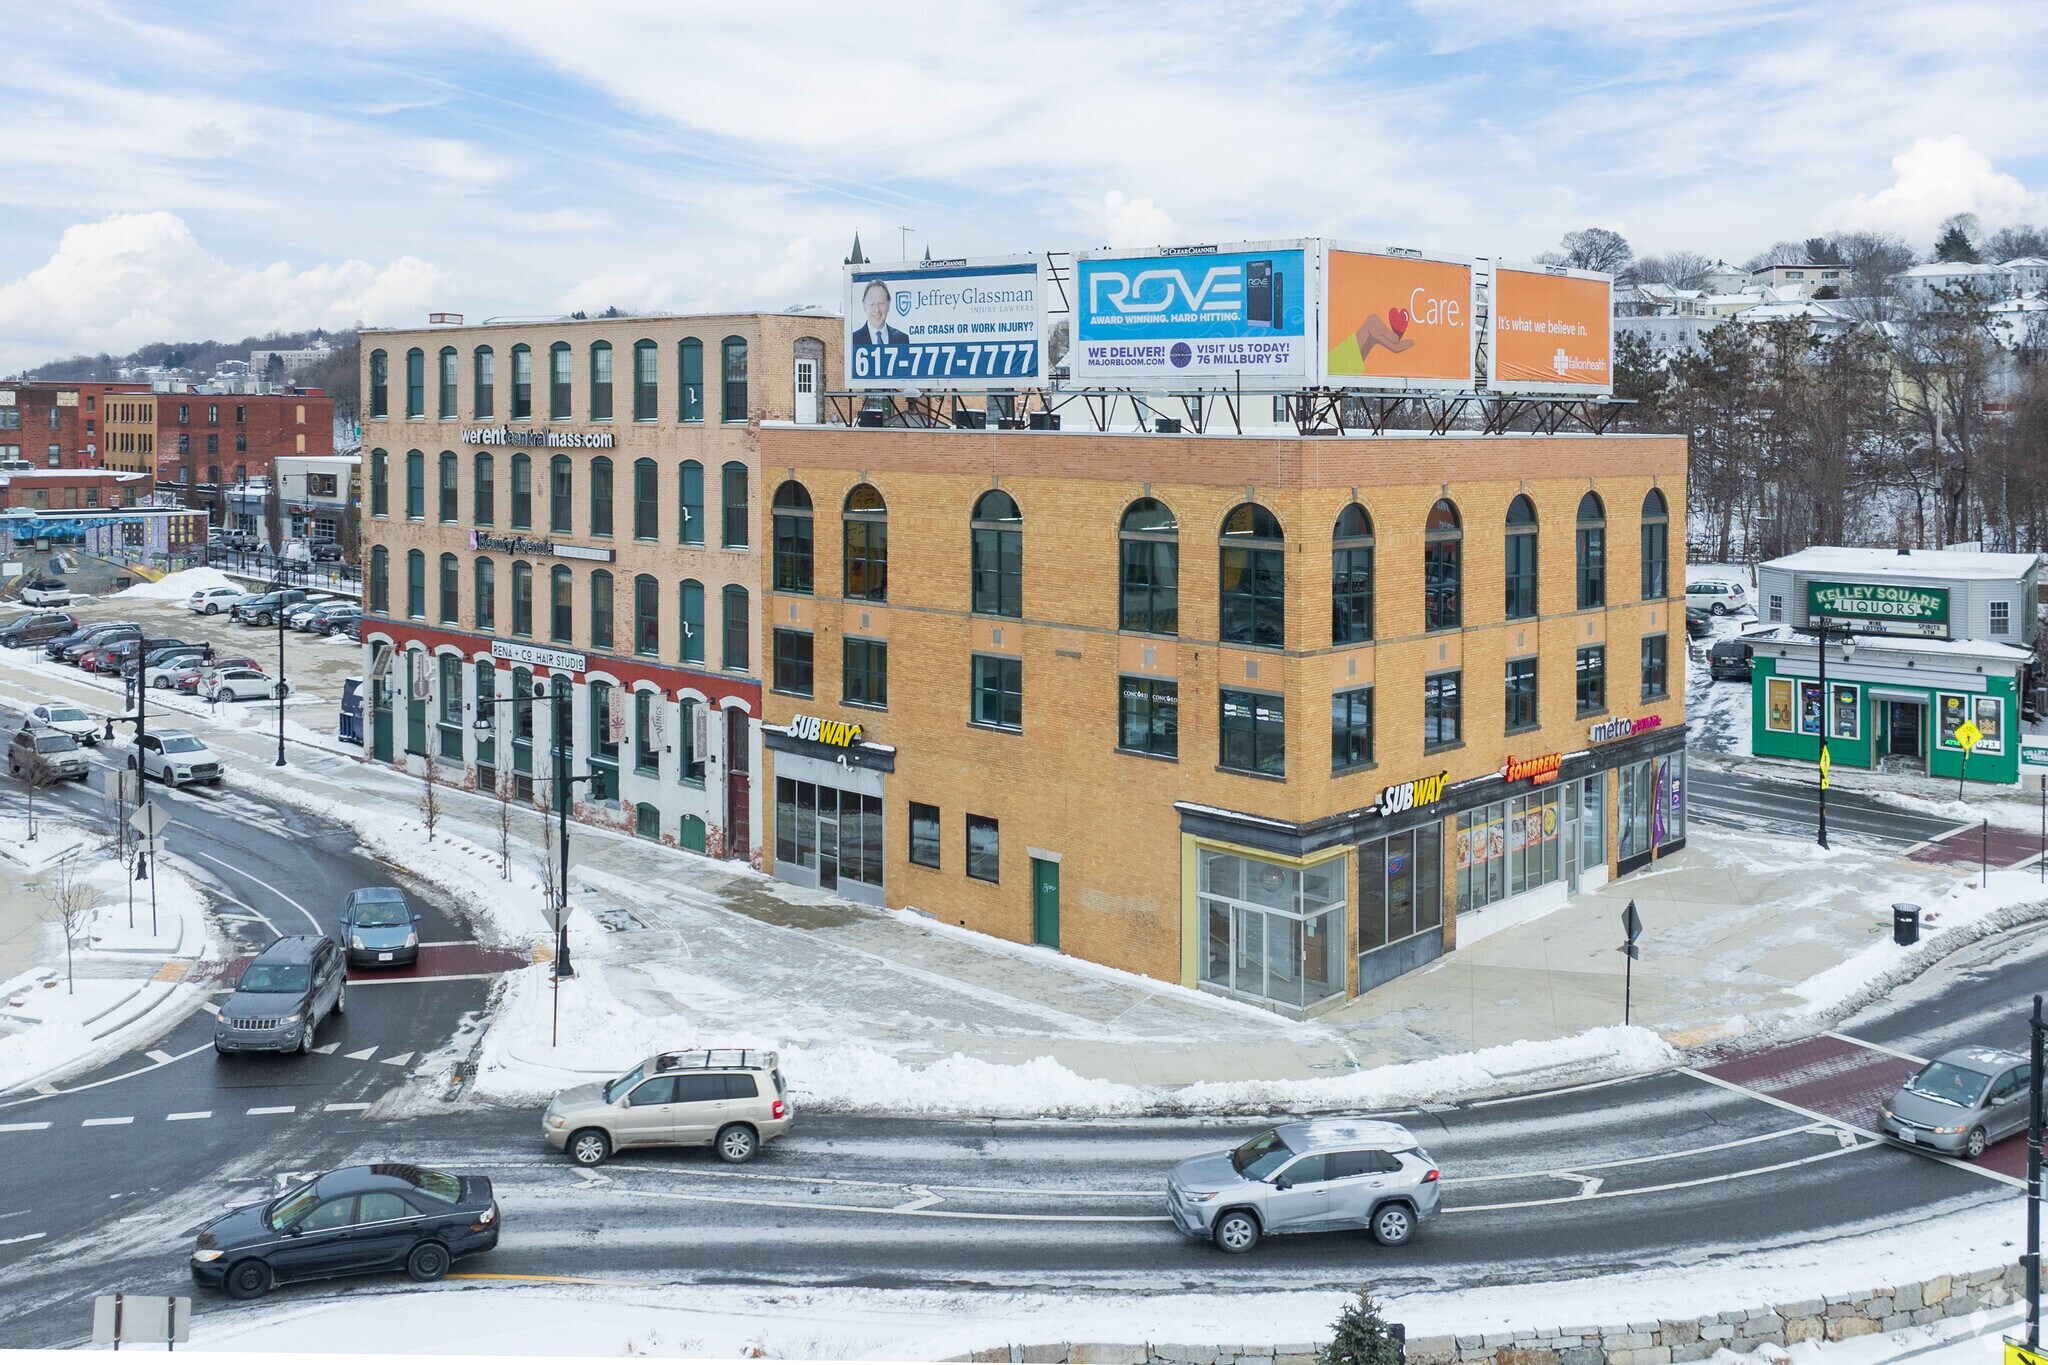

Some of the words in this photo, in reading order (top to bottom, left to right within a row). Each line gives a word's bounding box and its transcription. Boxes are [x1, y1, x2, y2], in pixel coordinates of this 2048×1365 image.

[915, 289, 960, 309] Jeffrey
[962, 287, 1033, 303] Glassman
[1090, 266, 1241, 314] ROVE
[970, 306, 996, 314] INJURY
[999, 304, 1034, 312] LAWYERS
[1410, 287, 1464, 326] Care.
[1090, 316, 1123, 325] AWARD
[1126, 314, 1169, 324] WINNING.
[1171, 313, 1197, 323] HARD
[1200, 312, 1241, 322] HITTING.
[1512, 317, 1532, 332] what
[1535, 322, 1546, 333] we
[1548, 319, 1576, 335] believe
[1578, 322, 1588, 336] in.
[909, 325, 925, 335] CAR
[928, 324, 955, 334] CRASH
[957, 323, 969, 333] OR
[971, 323, 996, 333] WORK
[999, 322, 1034, 332] INJURY?
[1088, 347, 1108, 358] WE
[1110, 346, 1165, 357] DELIVER!
[1197, 344, 1225, 354] VISIT
[1229, 343, 1244, 353] US
[1247, 342, 1290, 352] TODAY!
[855, 344, 1034, 377] 617-777-7777
[1088, 358, 1165, 367] MAJORBLOOM.COM
[1197, 355, 1211, 365] 76
[1213, 353, 1271, 364] MILLBURY
[1275, 353, 1289, 363] ST
[1568, 356, 1607, 371] fallonhealth
[478, 532, 514, 556] Beauty
[514, 536, 553, 556] Avenue
[1815, 586, 1875, 604] KELLEY
[1876, 587, 1940, 611] SQUARE
[1841, 600, 1915, 615] LIQUORS
[536, 652, 554, 665] HAIR
[788, 714, 862, 747] SUBWAY
[1594, 718, 1632, 742] metro
[1977, 740, 2000, 748] OPEN
[1507, 753, 1562, 782] SOMBRERO
[1381, 771, 1449, 817] SUBWAY
